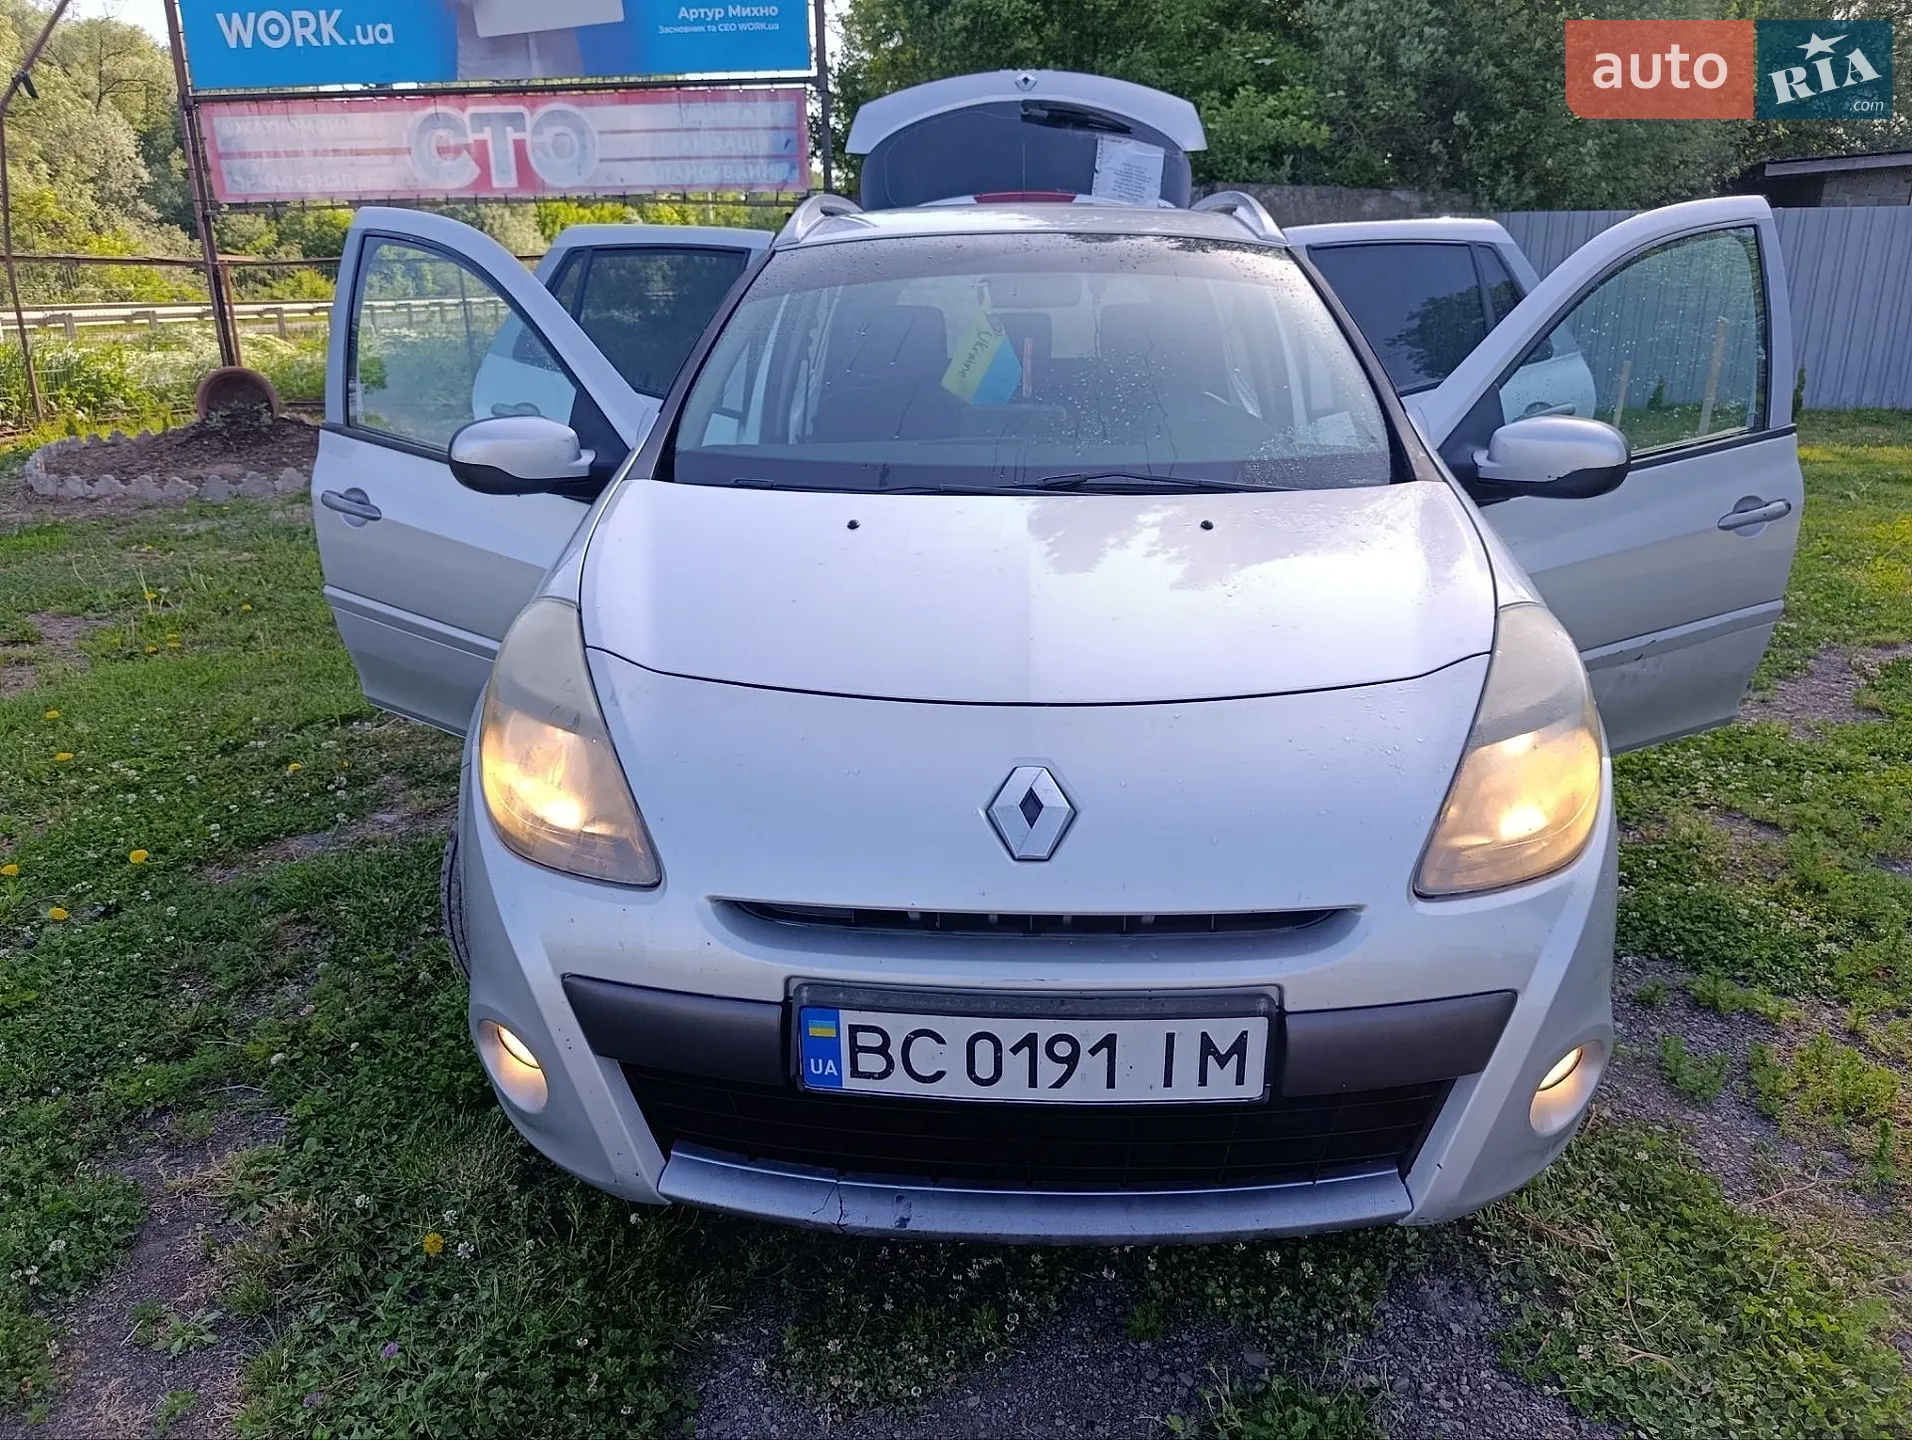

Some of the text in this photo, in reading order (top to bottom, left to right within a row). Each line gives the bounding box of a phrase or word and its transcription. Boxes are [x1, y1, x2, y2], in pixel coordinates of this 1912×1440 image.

[215, 9, 395, 49] WORK.ua
[658, 25, 706, 34] Засновник
[718, 23, 737, 32] CEO
[678, 5, 779, 21] Артур Михно
[410, 103, 599, 189] СТО
[956, 329, 995, 379] Ukraine
[810, 1057, 838, 1077] UA
[848, 1023, 1250, 1090] BC 0191 IM
